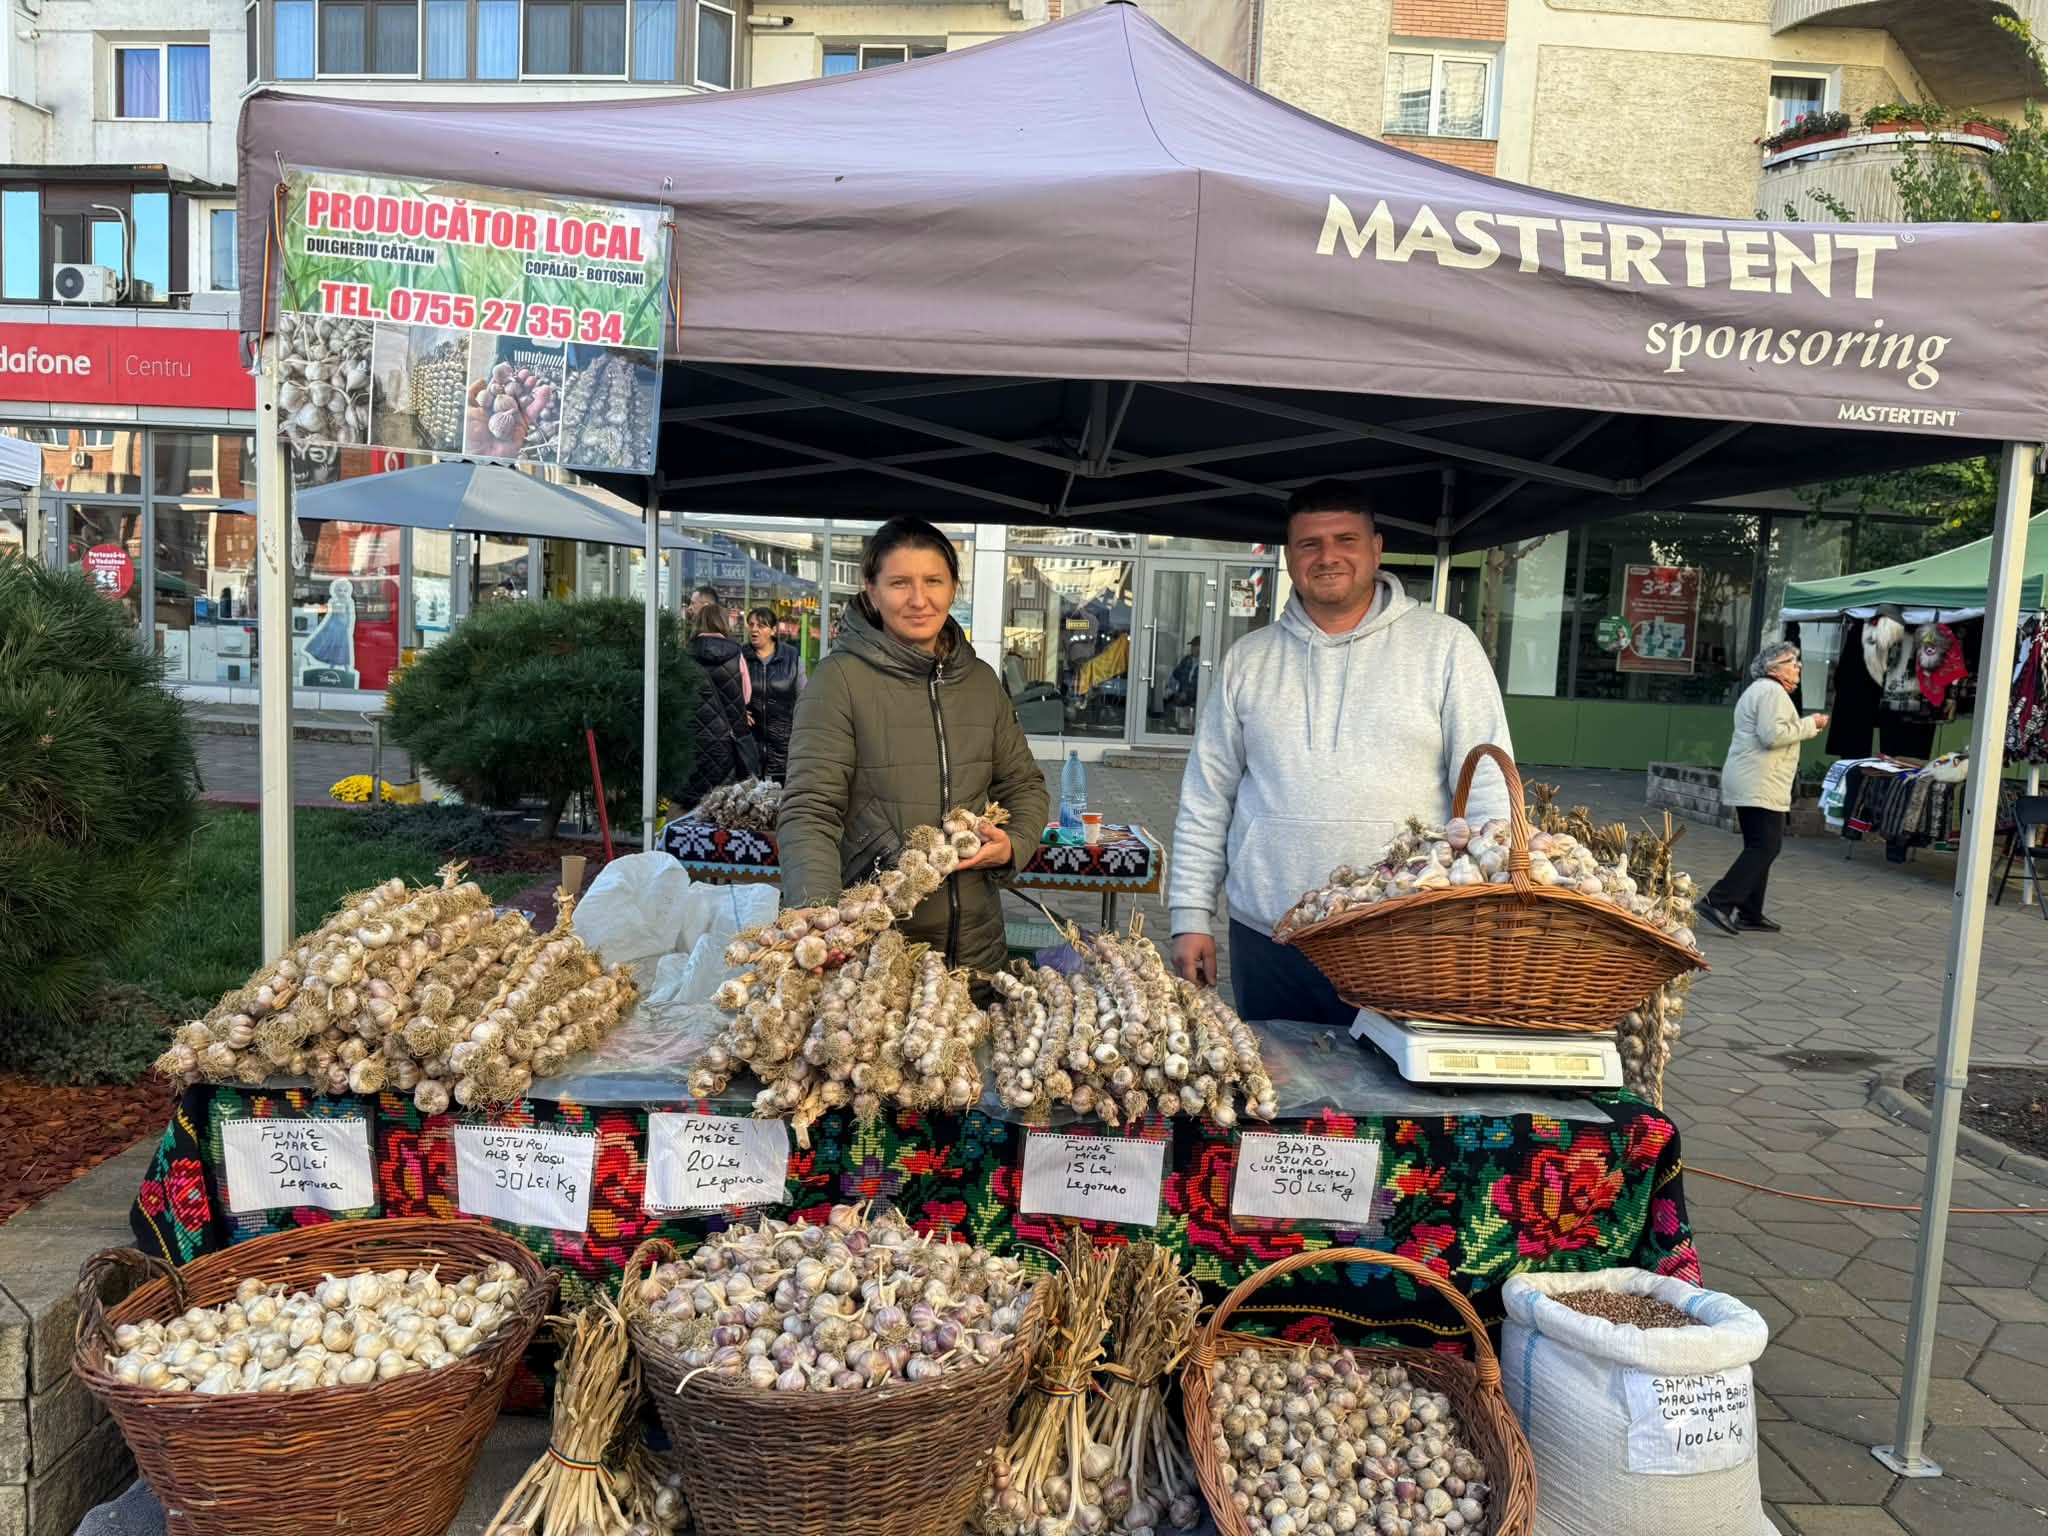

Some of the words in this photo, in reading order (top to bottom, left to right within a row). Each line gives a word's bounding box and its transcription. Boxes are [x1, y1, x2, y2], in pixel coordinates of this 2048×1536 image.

[308, 190, 536, 250] PRODUCĂTOR
[545, 216, 644, 261] LOCAL
[306, 237, 377, 258] DULGHERIU
[381, 241, 435, 264] CĂTĂLIN
[525, 260, 577, 278] COPĂLĂU
[321, 283, 382, 317] TEL.
[389, 289, 474, 328] 0755
[482, 301, 521, 332] 27
[529, 306, 573, 337] 35
[580, 312, 624, 343] 34
[126, 354, 191, 377] Centru
[1646, 319, 1952, 390] sponsoring
[1837, 403, 1958, 427] MASTERTENT
[275, 1141, 328, 1151] MARE
[485, 1150, 509, 1161] ALB
[269, 1152, 301, 1174] 30
[686, 1149, 714, 1172] 20
[495, 1169, 523, 1190] 30
[1272, 1178, 1302, 1195] 50
[1676, 1426, 1703, 1453] 100
